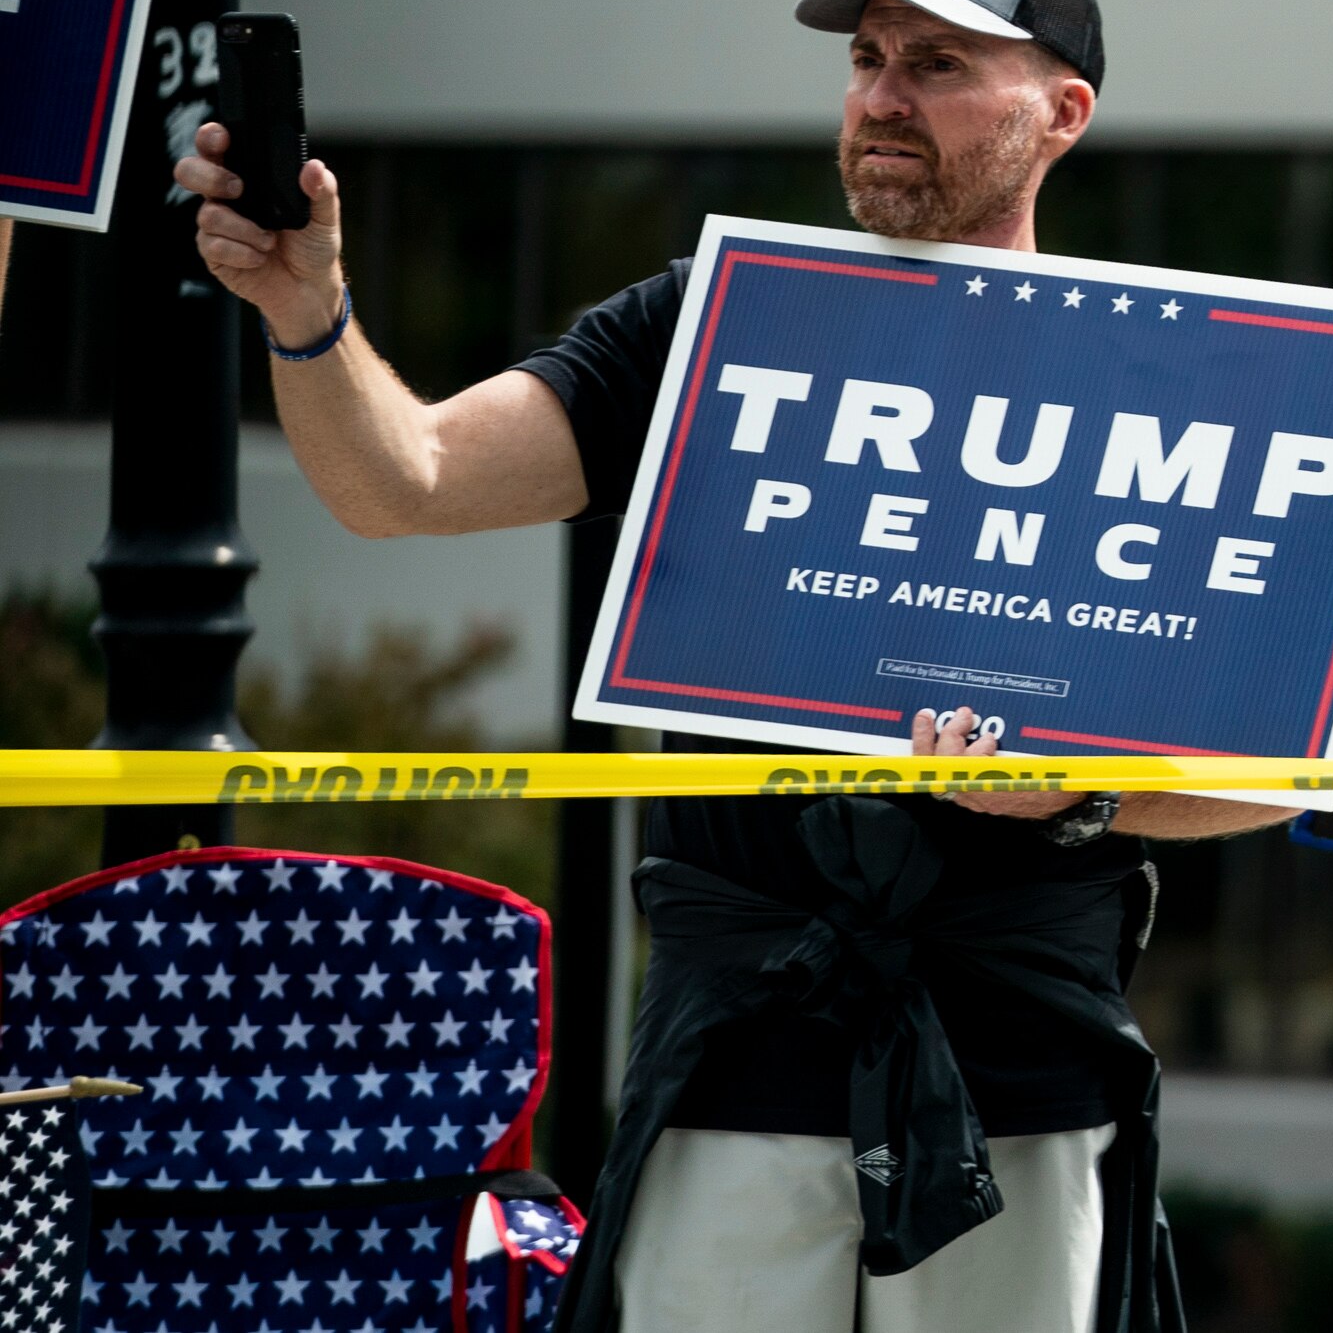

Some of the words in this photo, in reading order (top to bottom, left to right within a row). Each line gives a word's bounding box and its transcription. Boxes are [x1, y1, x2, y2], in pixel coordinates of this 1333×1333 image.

[743, 479, 1276, 595] PENCE
[786, 567, 880, 600] KEEP
[888, 581, 1053, 623] AMERICA
[1066, 603, 1199, 641] GREAT!
